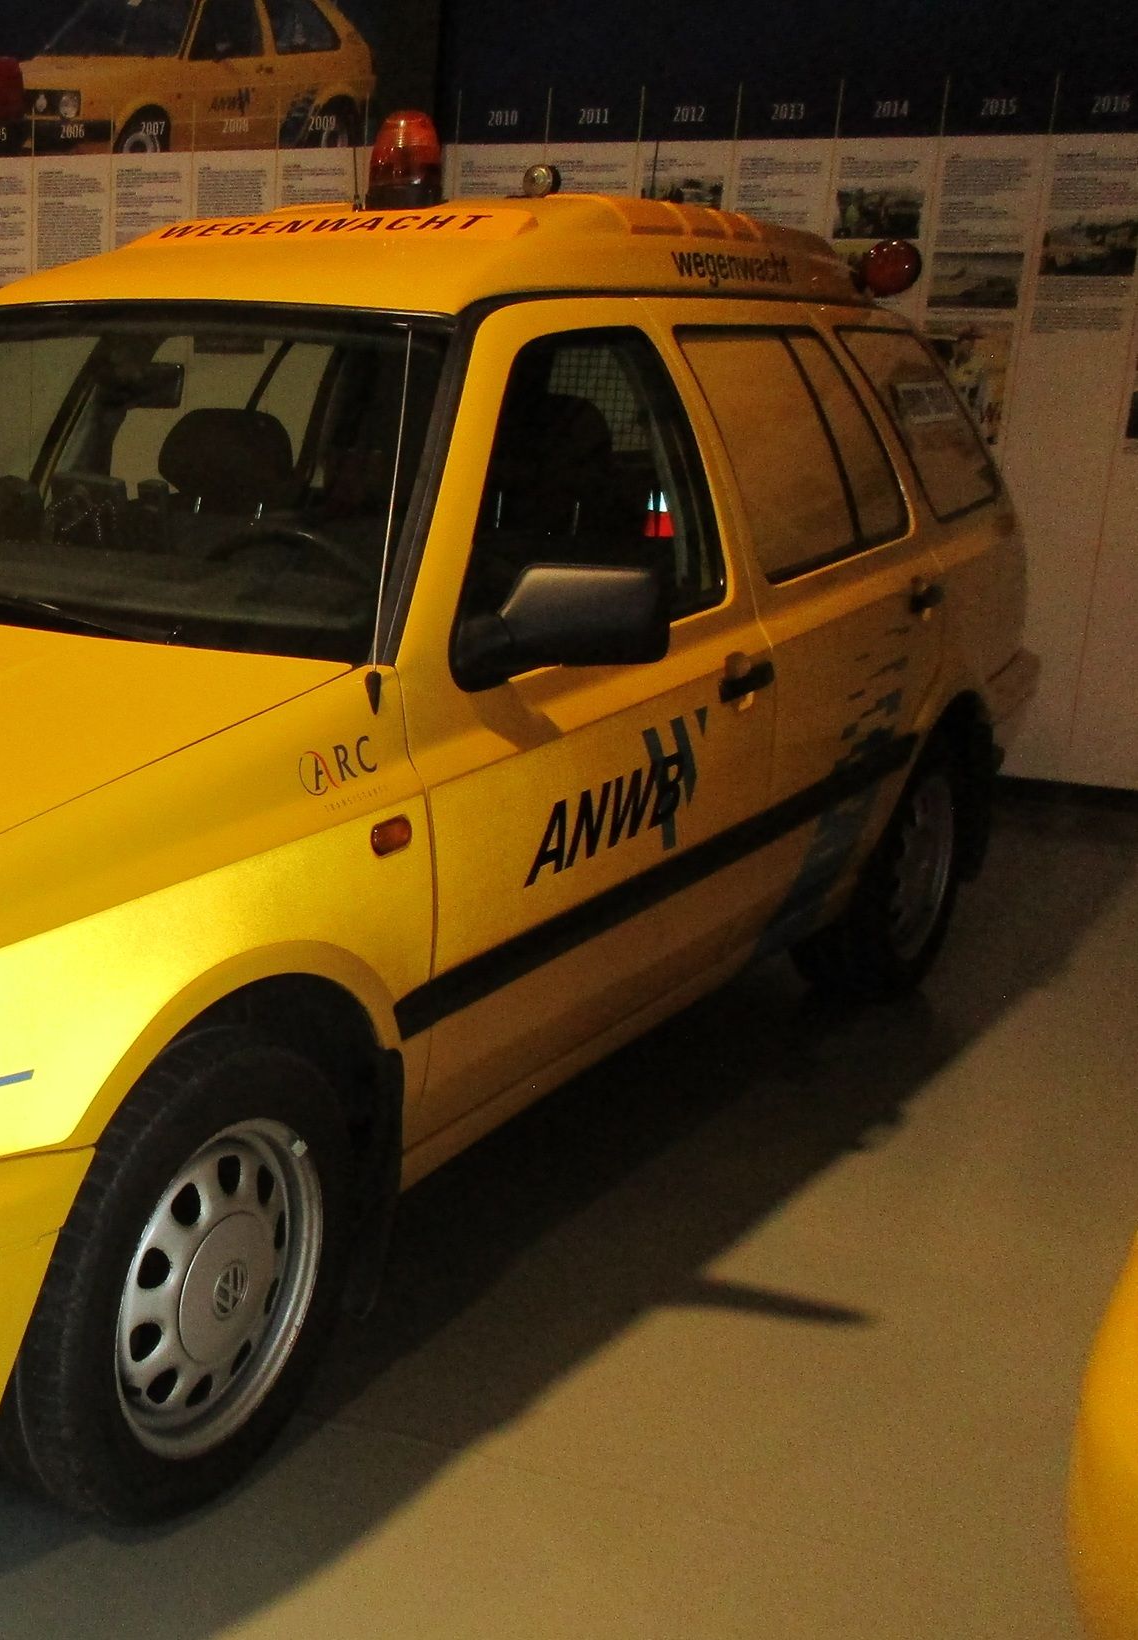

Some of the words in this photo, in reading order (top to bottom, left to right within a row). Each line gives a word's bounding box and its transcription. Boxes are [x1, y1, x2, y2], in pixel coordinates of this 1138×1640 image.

[578, 107, 609, 125] 2011
[673, 106, 705, 123] 2012
[771, 103, 805, 121] 2013
[874, 100, 909, 118] 2014
[980, 98, 1018, 116] 2015
[308, 115, 336, 131] 2009
[488, 110, 518, 127] 2010
[60, 124, 85, 139] 2006
[140, 121, 166, 136] 2007
[160, 214, 494, 239] WEGENWACHT
[671, 251, 793, 288] wegenwacht
[299, 735, 378, 796] ARC
[523, 751, 685, 889] ANWB
